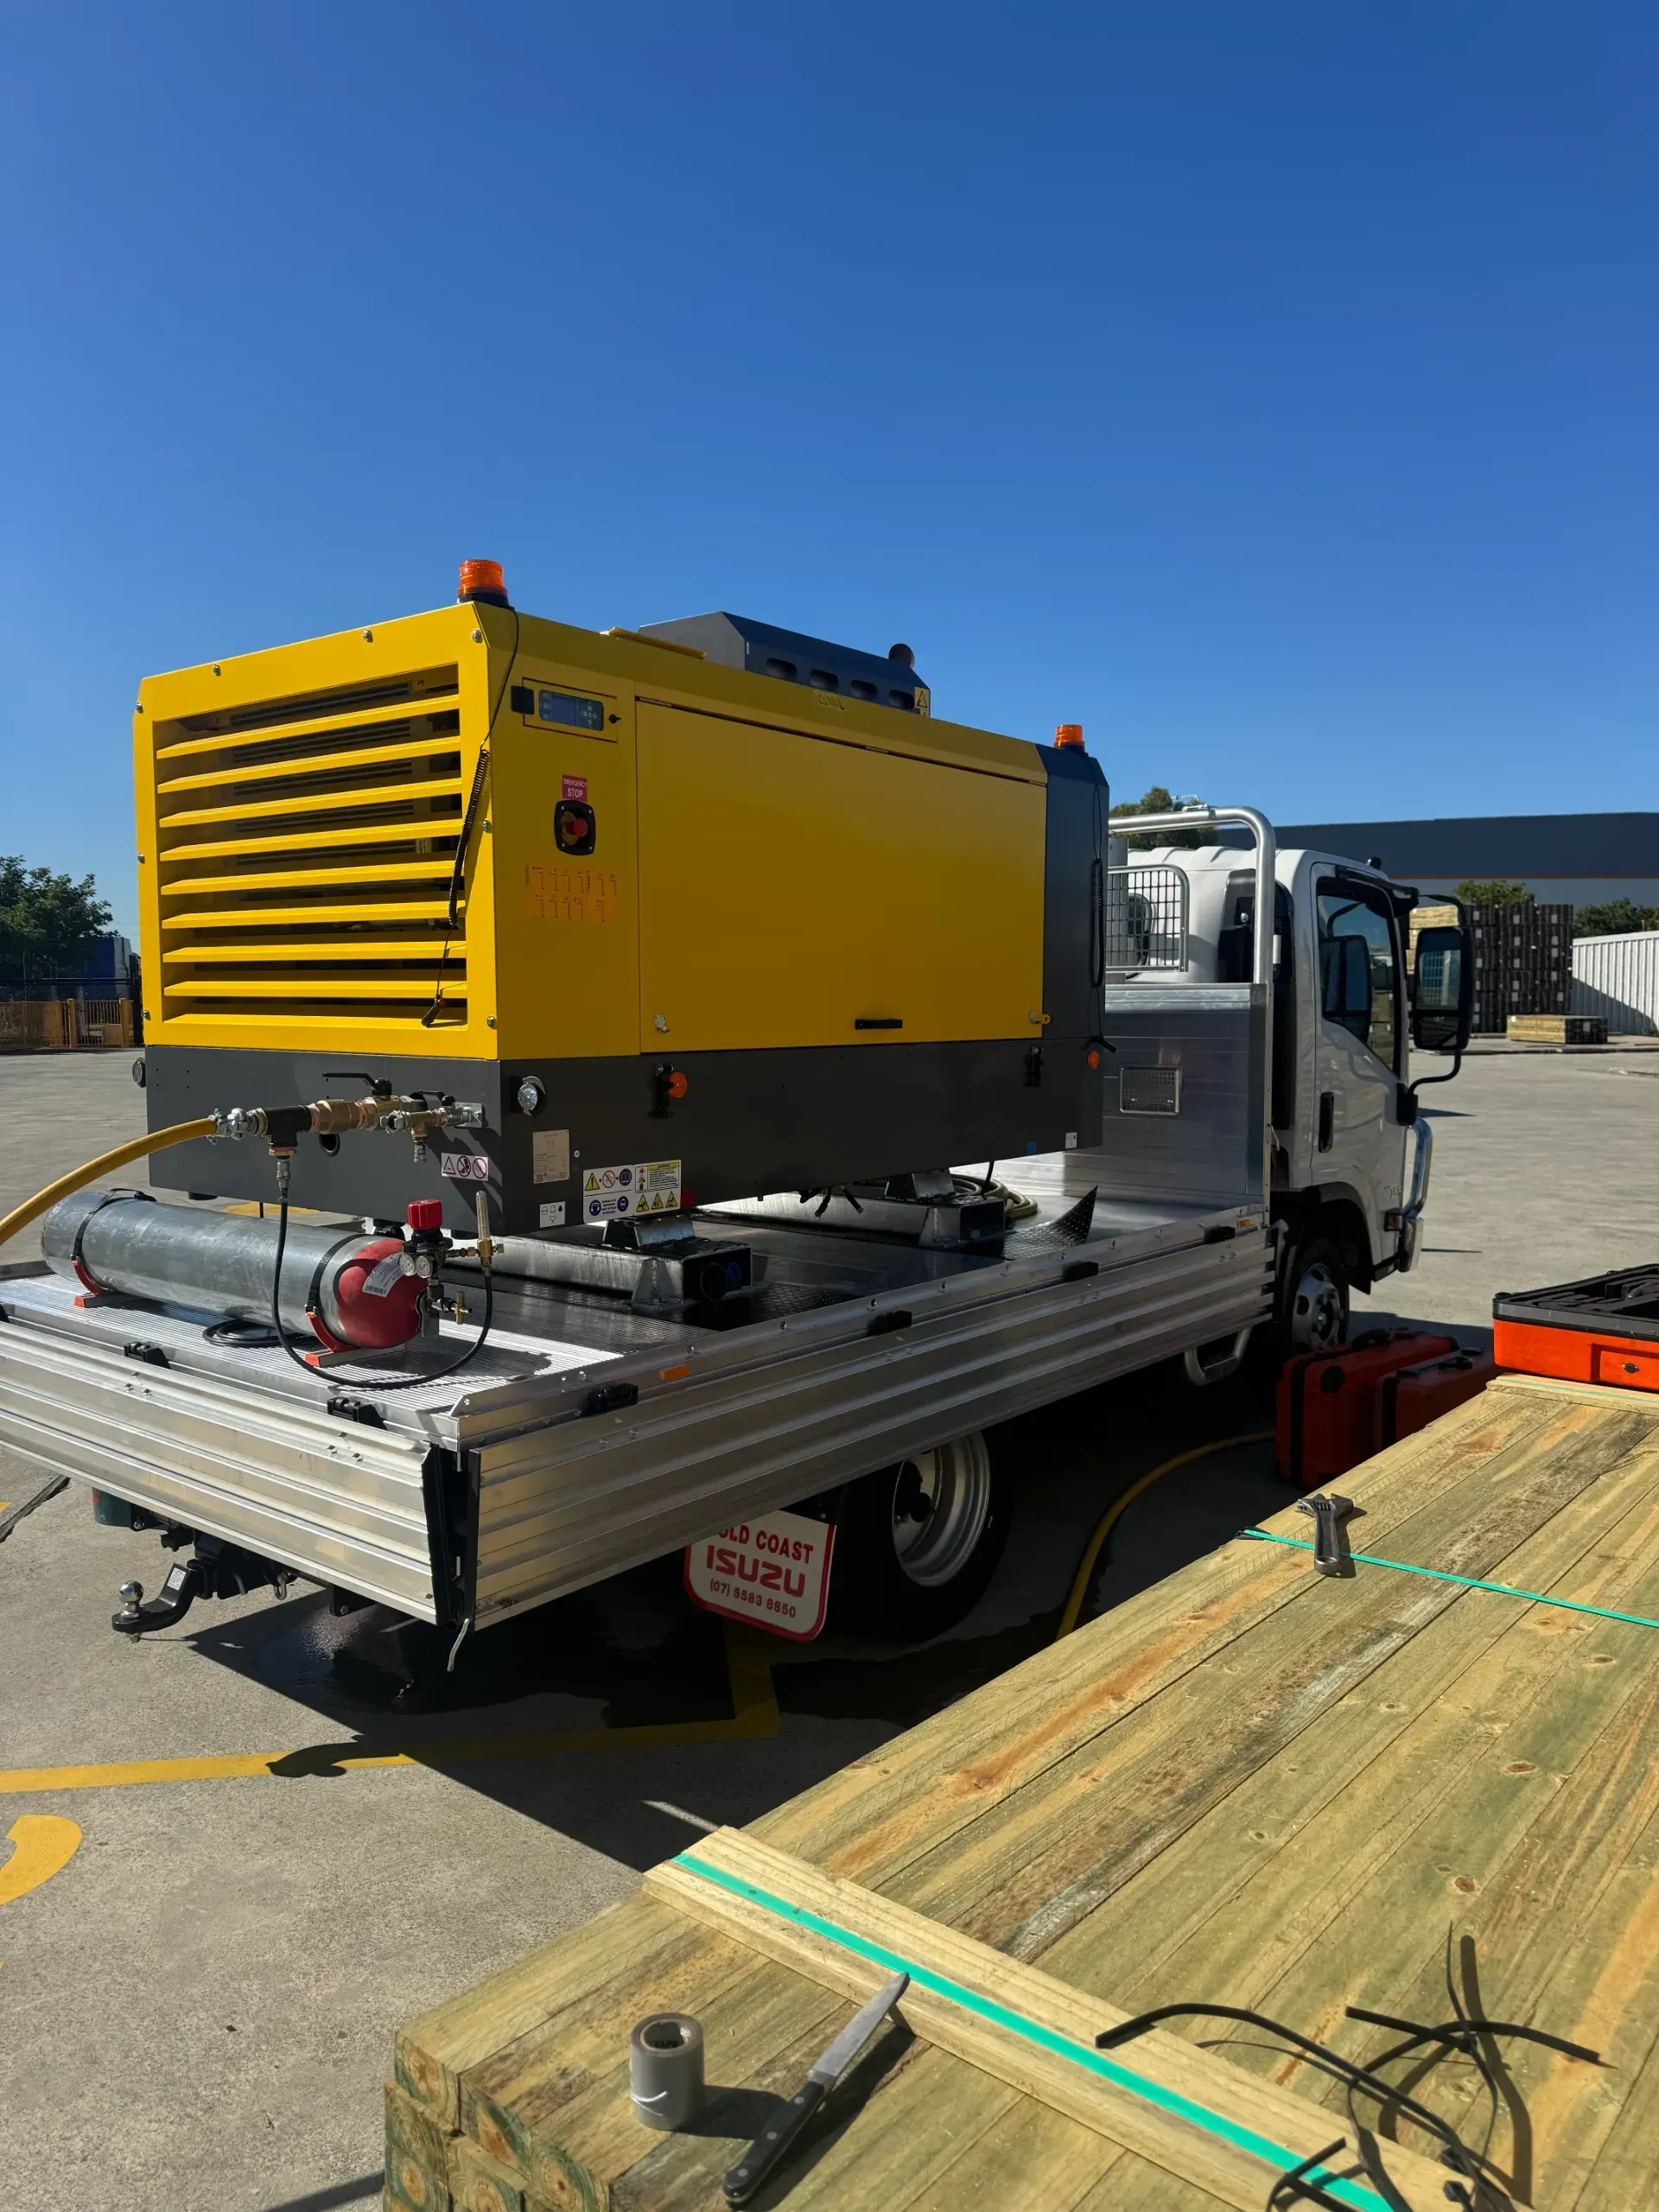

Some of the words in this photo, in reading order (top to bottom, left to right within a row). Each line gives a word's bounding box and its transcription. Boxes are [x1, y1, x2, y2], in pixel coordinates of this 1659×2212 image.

[563, 778, 587, 787] EMERGENCY
[567, 788, 583, 798] STOP
[718, 1525, 750, 1544] OLD
[756, 1530, 814, 1564] COAST
[706, 1545, 806, 1598] ISUZU
[710, 1578, 731, 1597] (07)
[734, 1587, 762, 1606] 5583
[766, 1598, 797, 1618] 8850
